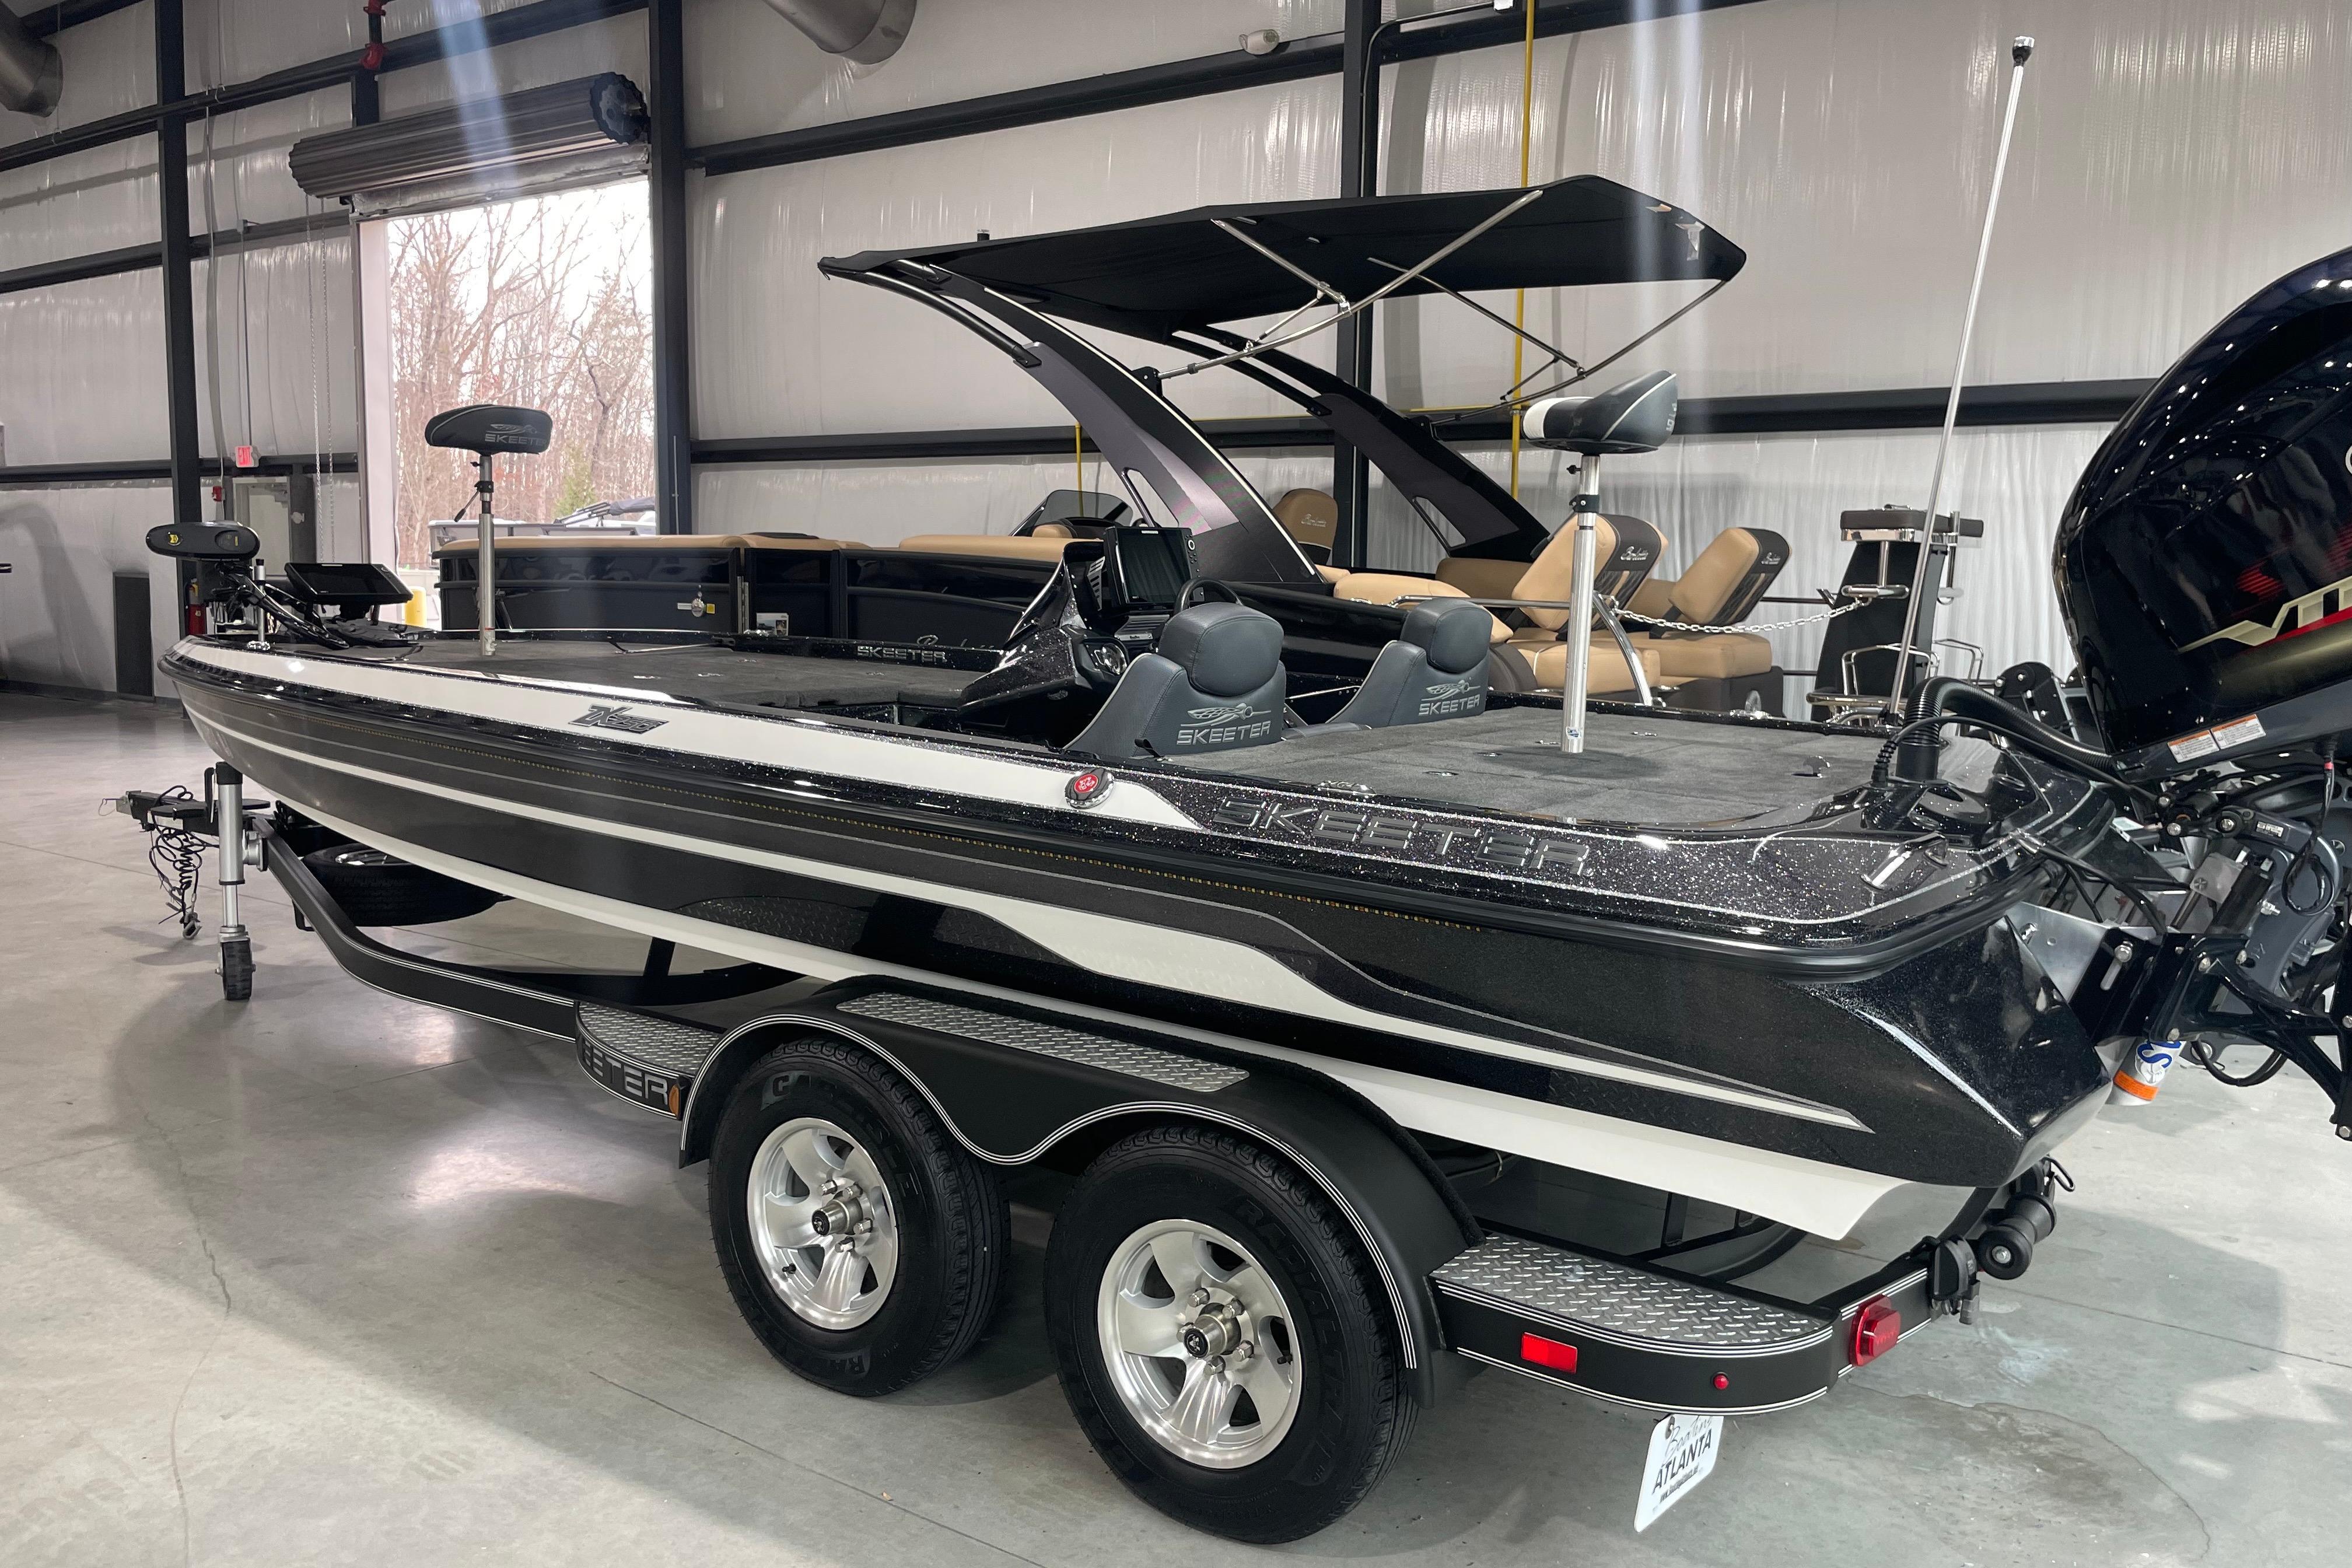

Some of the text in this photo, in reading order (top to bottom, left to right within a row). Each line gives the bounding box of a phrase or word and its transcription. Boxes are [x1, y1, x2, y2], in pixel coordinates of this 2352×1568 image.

[857, 645, 946, 663] SKEETER
[1418, 694, 1480, 716] SKEETER
[1176, 720, 1271, 746] SKEETER
[1213, 796, 1590, 876] SKEETER
[583, 1039, 668, 1105] EETER
[1652, 1428, 1713, 1495] ATLANTA
